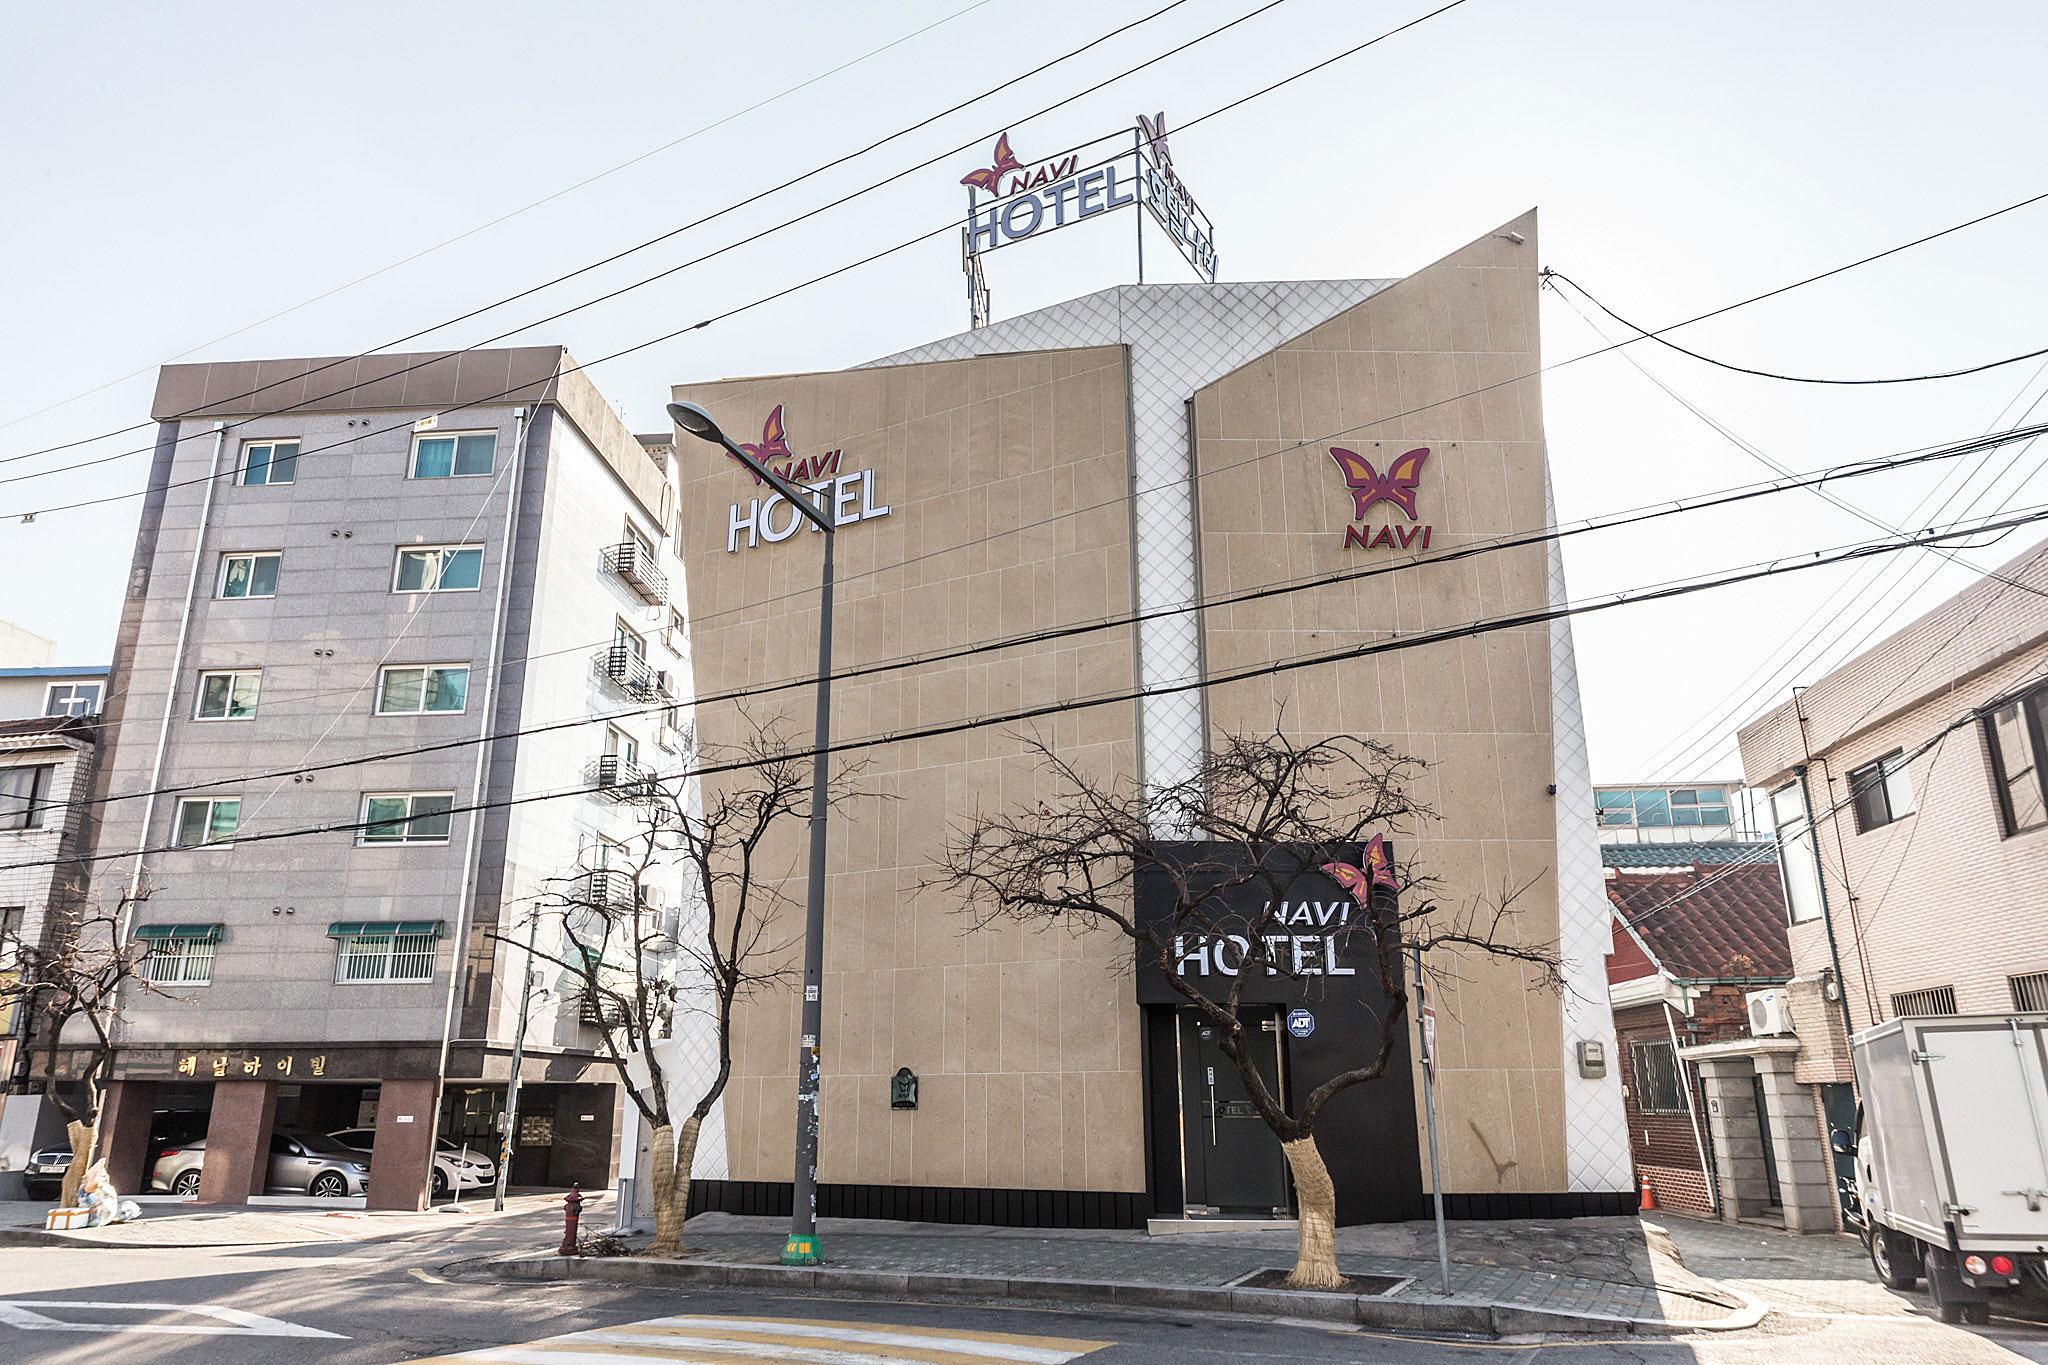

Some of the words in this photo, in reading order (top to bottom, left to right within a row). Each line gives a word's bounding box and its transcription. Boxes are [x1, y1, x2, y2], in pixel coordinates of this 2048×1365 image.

[1009, 153, 1079, 195] NAVI
[968, 166, 1134, 254] HOTEL
[770, 448, 844, 489] NAVI
[727, 468, 892, 553] HOTEL
[1343, 524, 1432, 550] NAVI
[1174, 935, 1356, 977] HOTEL
[1292, 1017, 1311, 1029] ADT
